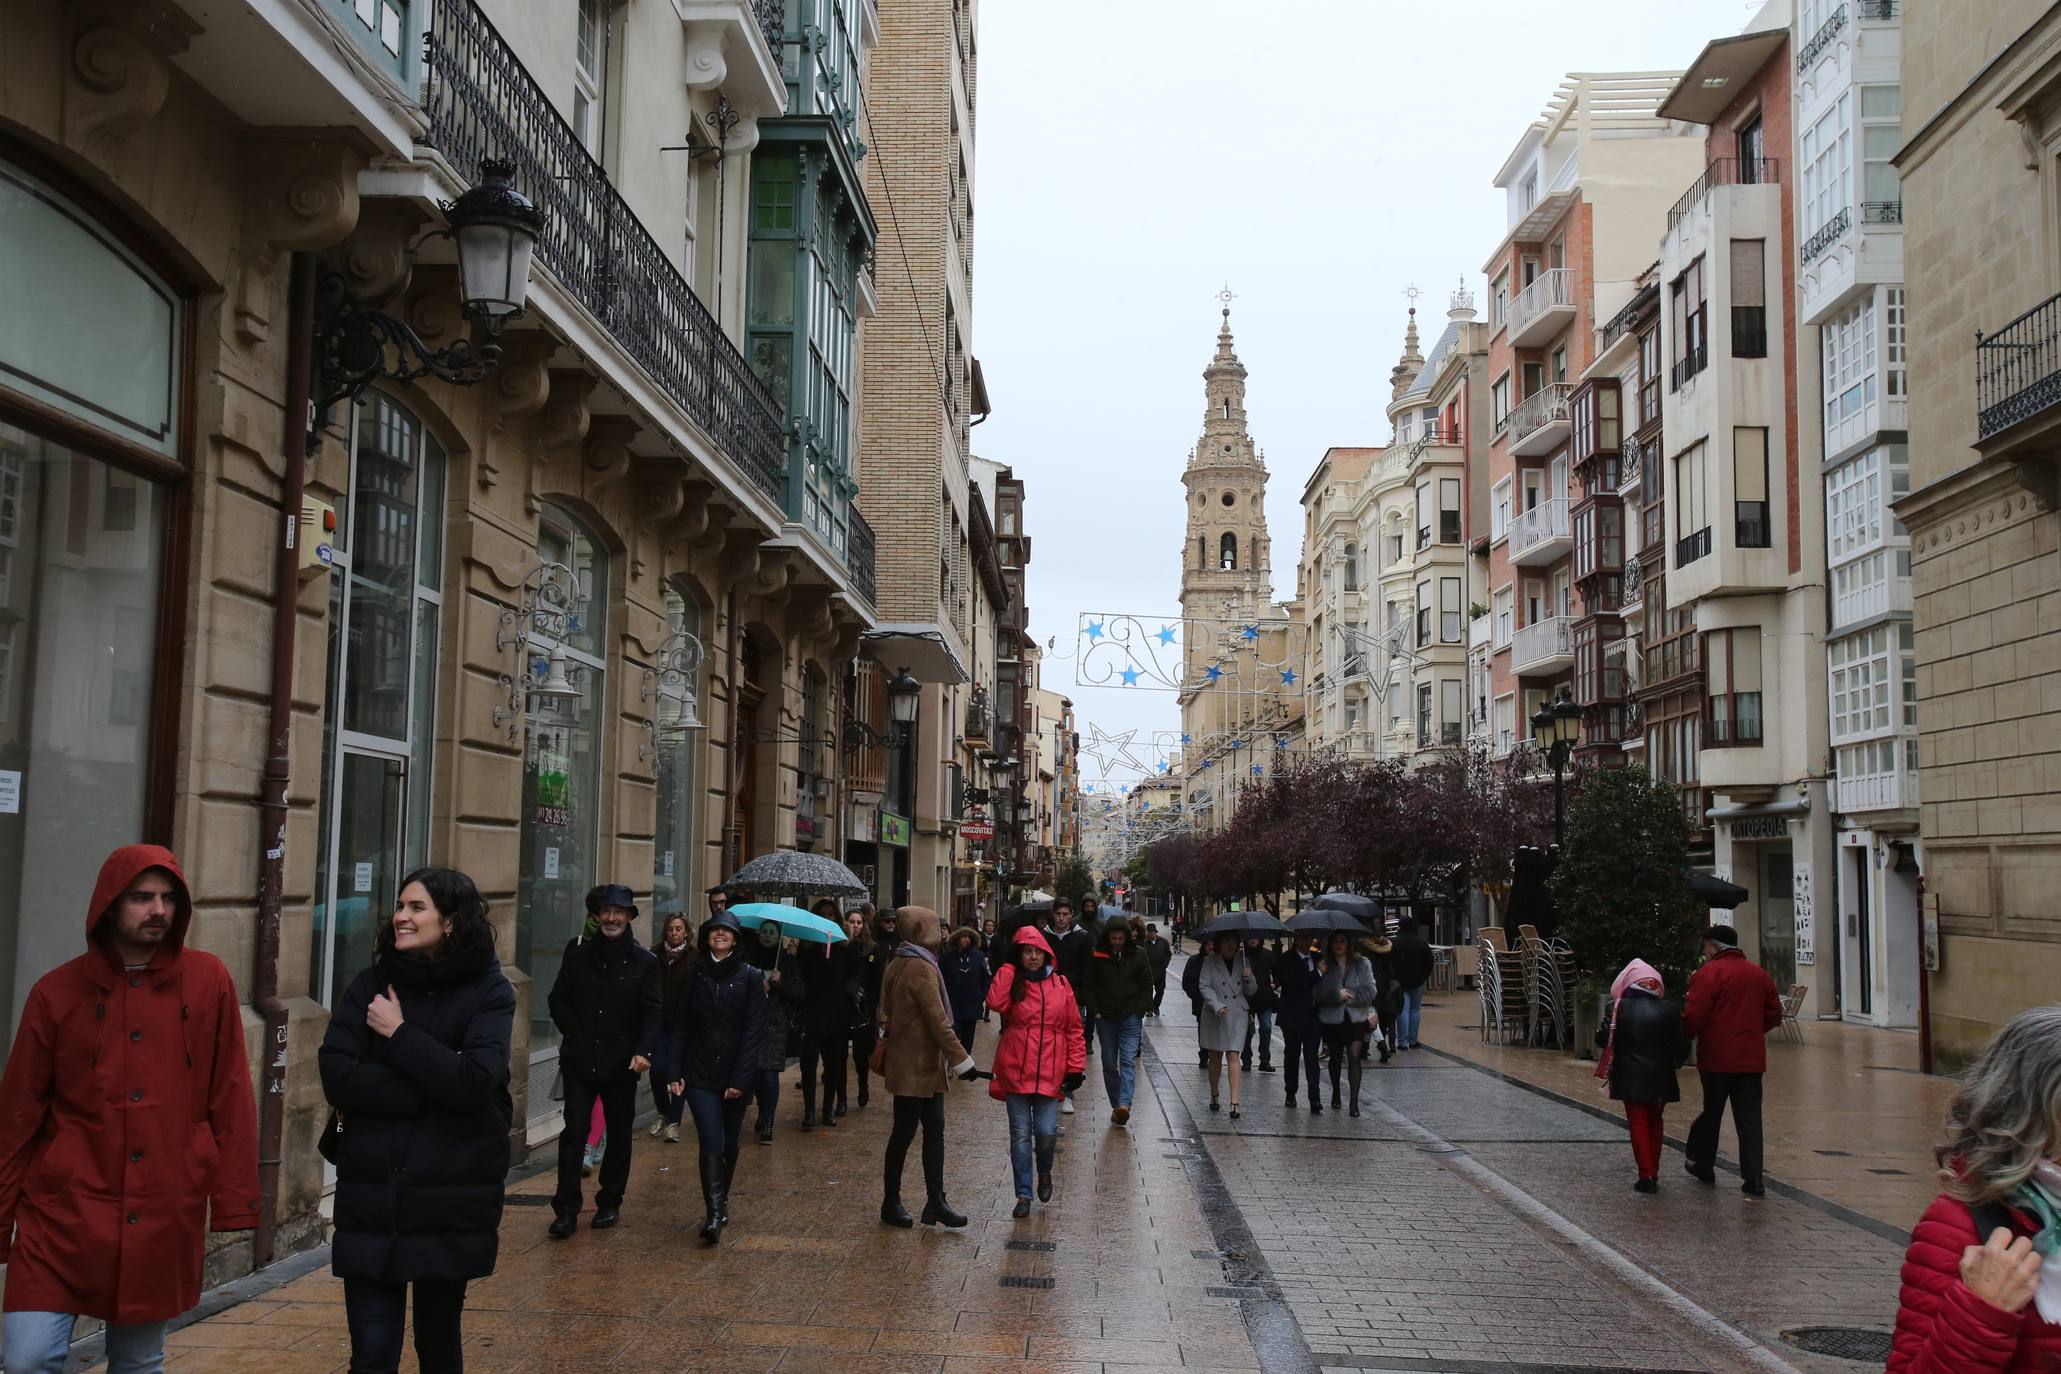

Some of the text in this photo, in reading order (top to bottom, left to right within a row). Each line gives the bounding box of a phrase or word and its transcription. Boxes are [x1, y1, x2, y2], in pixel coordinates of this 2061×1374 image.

[545, 807, 553, 823] 24
[553, 808, 561, 824] 26
[960, 825, 993, 835] MOSCOVITAS
[1731, 817, 1787, 838] ORTOPEDIA
